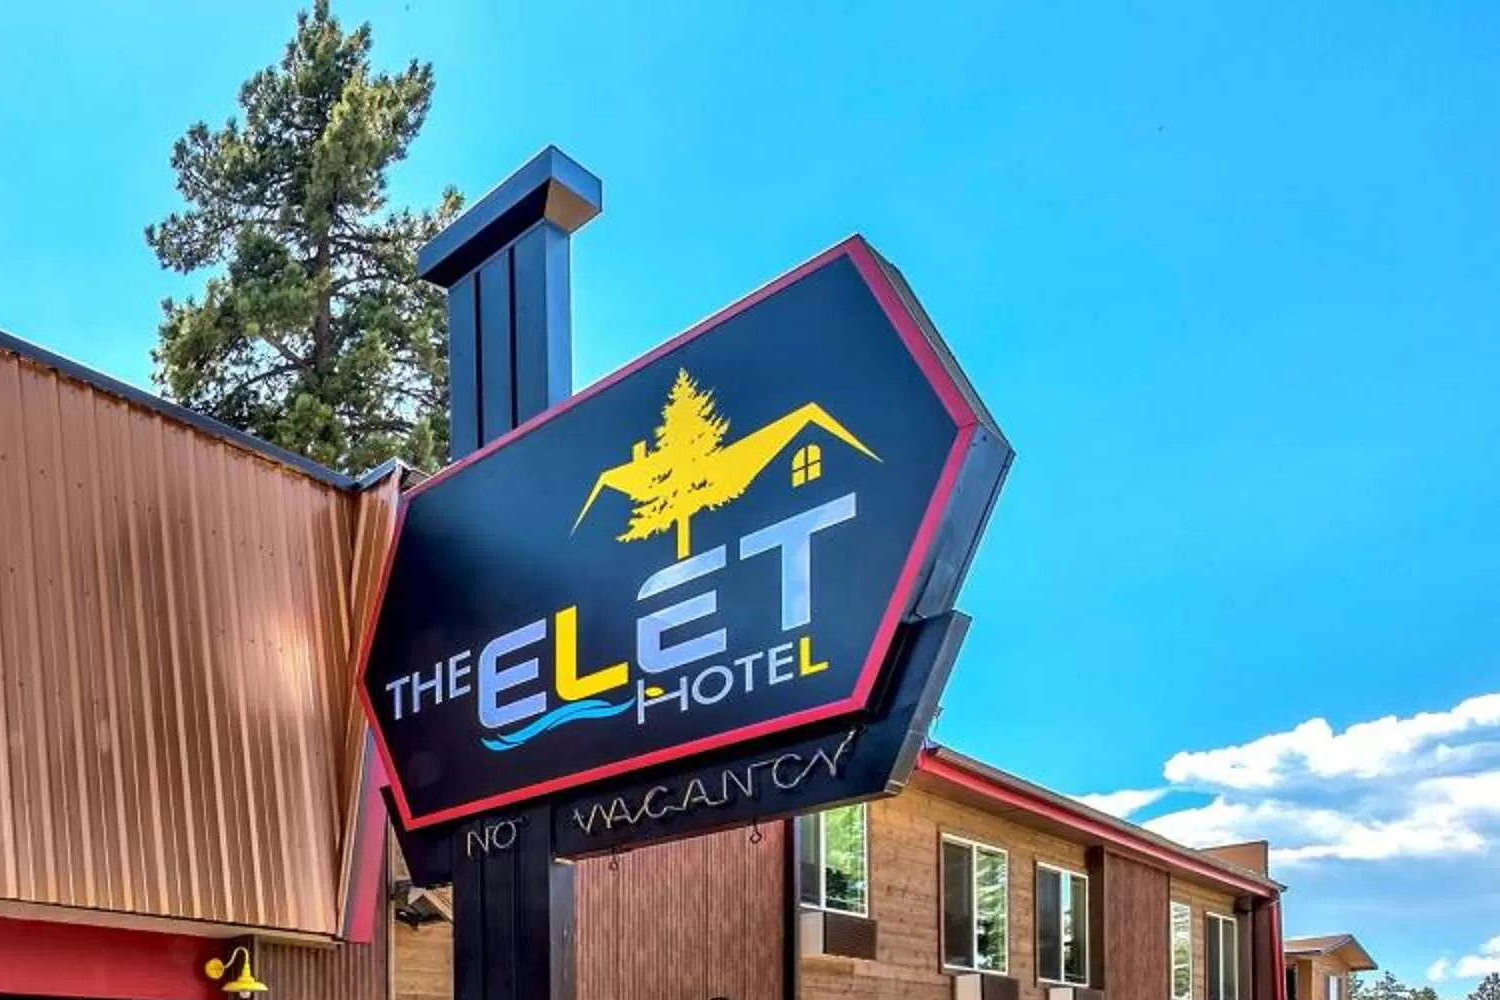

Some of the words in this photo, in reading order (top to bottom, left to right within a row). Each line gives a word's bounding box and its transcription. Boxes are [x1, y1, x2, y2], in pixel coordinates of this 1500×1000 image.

[385, 649, 471, 721] THE
[478, 491, 857, 729] ELET
[637, 636, 830, 725] HOTEL
[466, 820, 518, 859] NO
[573, 730, 856, 835] VACANCY
